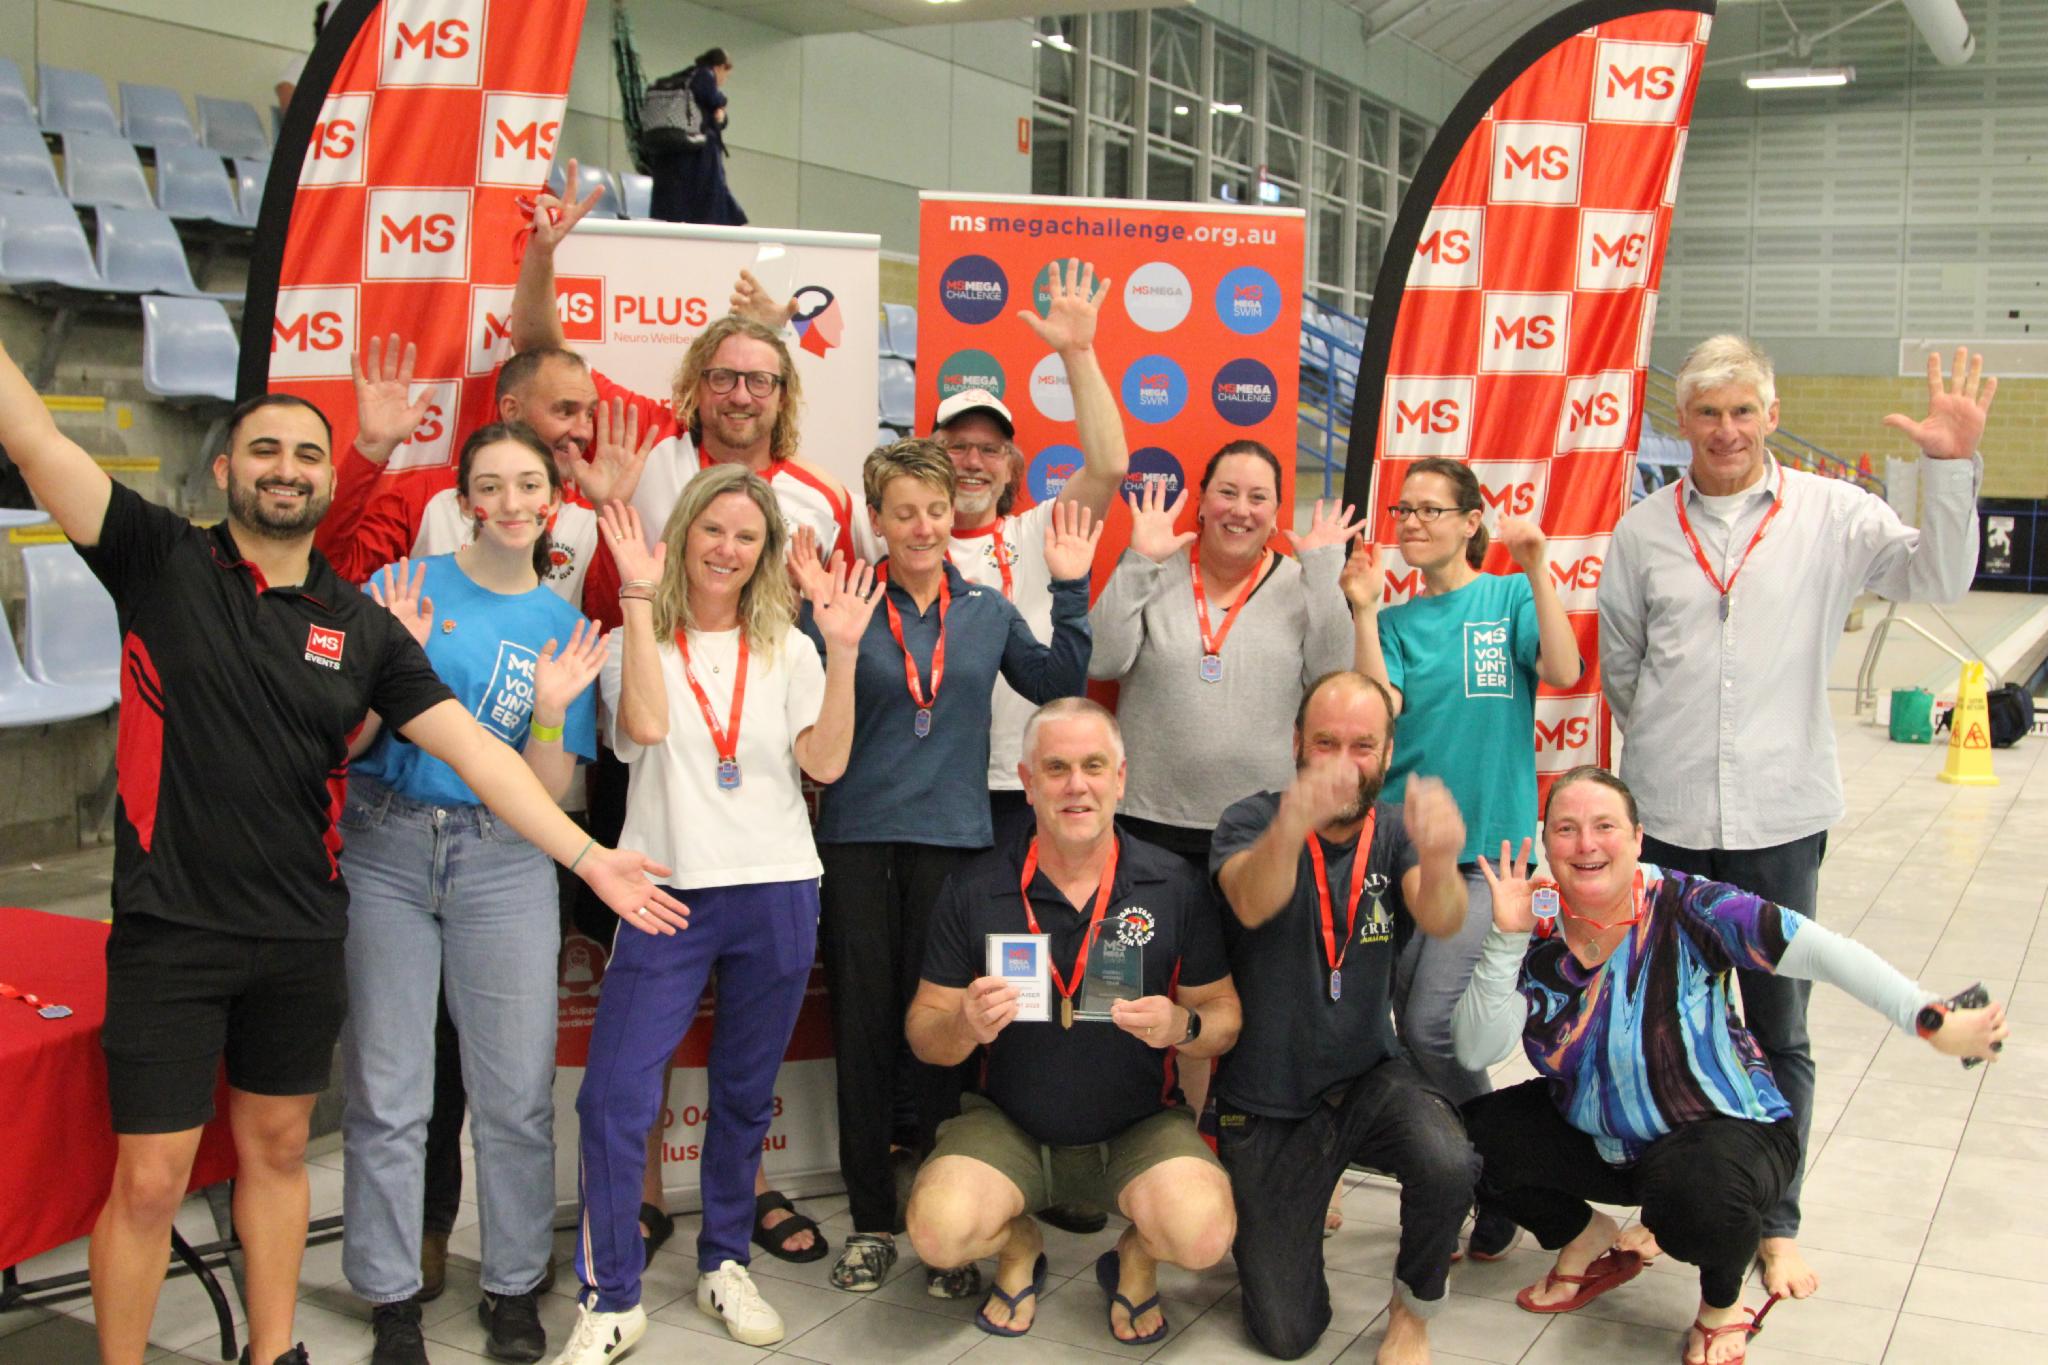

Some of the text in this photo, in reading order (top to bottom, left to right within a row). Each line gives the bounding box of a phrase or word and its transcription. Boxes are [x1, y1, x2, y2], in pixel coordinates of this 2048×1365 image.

[394, 19, 470, 60] MS
[1606, 64, 1674, 101] MS
[1504, 145, 1569, 181] MS
[380, 213, 455, 254] MS
[950, 213, 1276, 246] msmegachallenge.org.au
[1416, 230, 1471, 264] MS
[1591, 232, 1645, 267] MS
[946, 290, 1001, 301] CHALLENGE
[1233, 285, 1263, 300] MS
[614, 295, 708, 327] PLUS
[1233, 300, 1262, 308] MEGA
[1233, 307, 1263, 317] SWIM
[272, 311, 343, 352] MS
[614, 332, 692, 345] Neuro Wellbe
[1493, 314, 1555, 350] MS
[1139, 373, 1170, 389] MS
[1139, 388, 1168, 397] MEGA
[1139, 396, 1169, 406] SWIM
[1217, 393, 1271, 403] CHALLENGE
[1396, 399, 1460, 434] MS
[1569, 392, 1620, 432] MS
[1479, 482, 1535, 517] MS
[1550, 556, 1603, 592] MS
[312, 632, 340, 652] MS
[1473, 627, 1507, 645] MS
[305, 653, 340, 670] EVENTS
[1474, 647, 1507, 661] VOL
[1474, 660, 1507, 673] UNT
[1476, 673, 1507, 687] EER
[497, 689, 533, 716] UNT
[490, 705, 520, 730] EER
[1534, 717, 1589, 753] MS
[1361, 922, 1394, 937] CRE
[1103, 939, 1127, 952] MS
